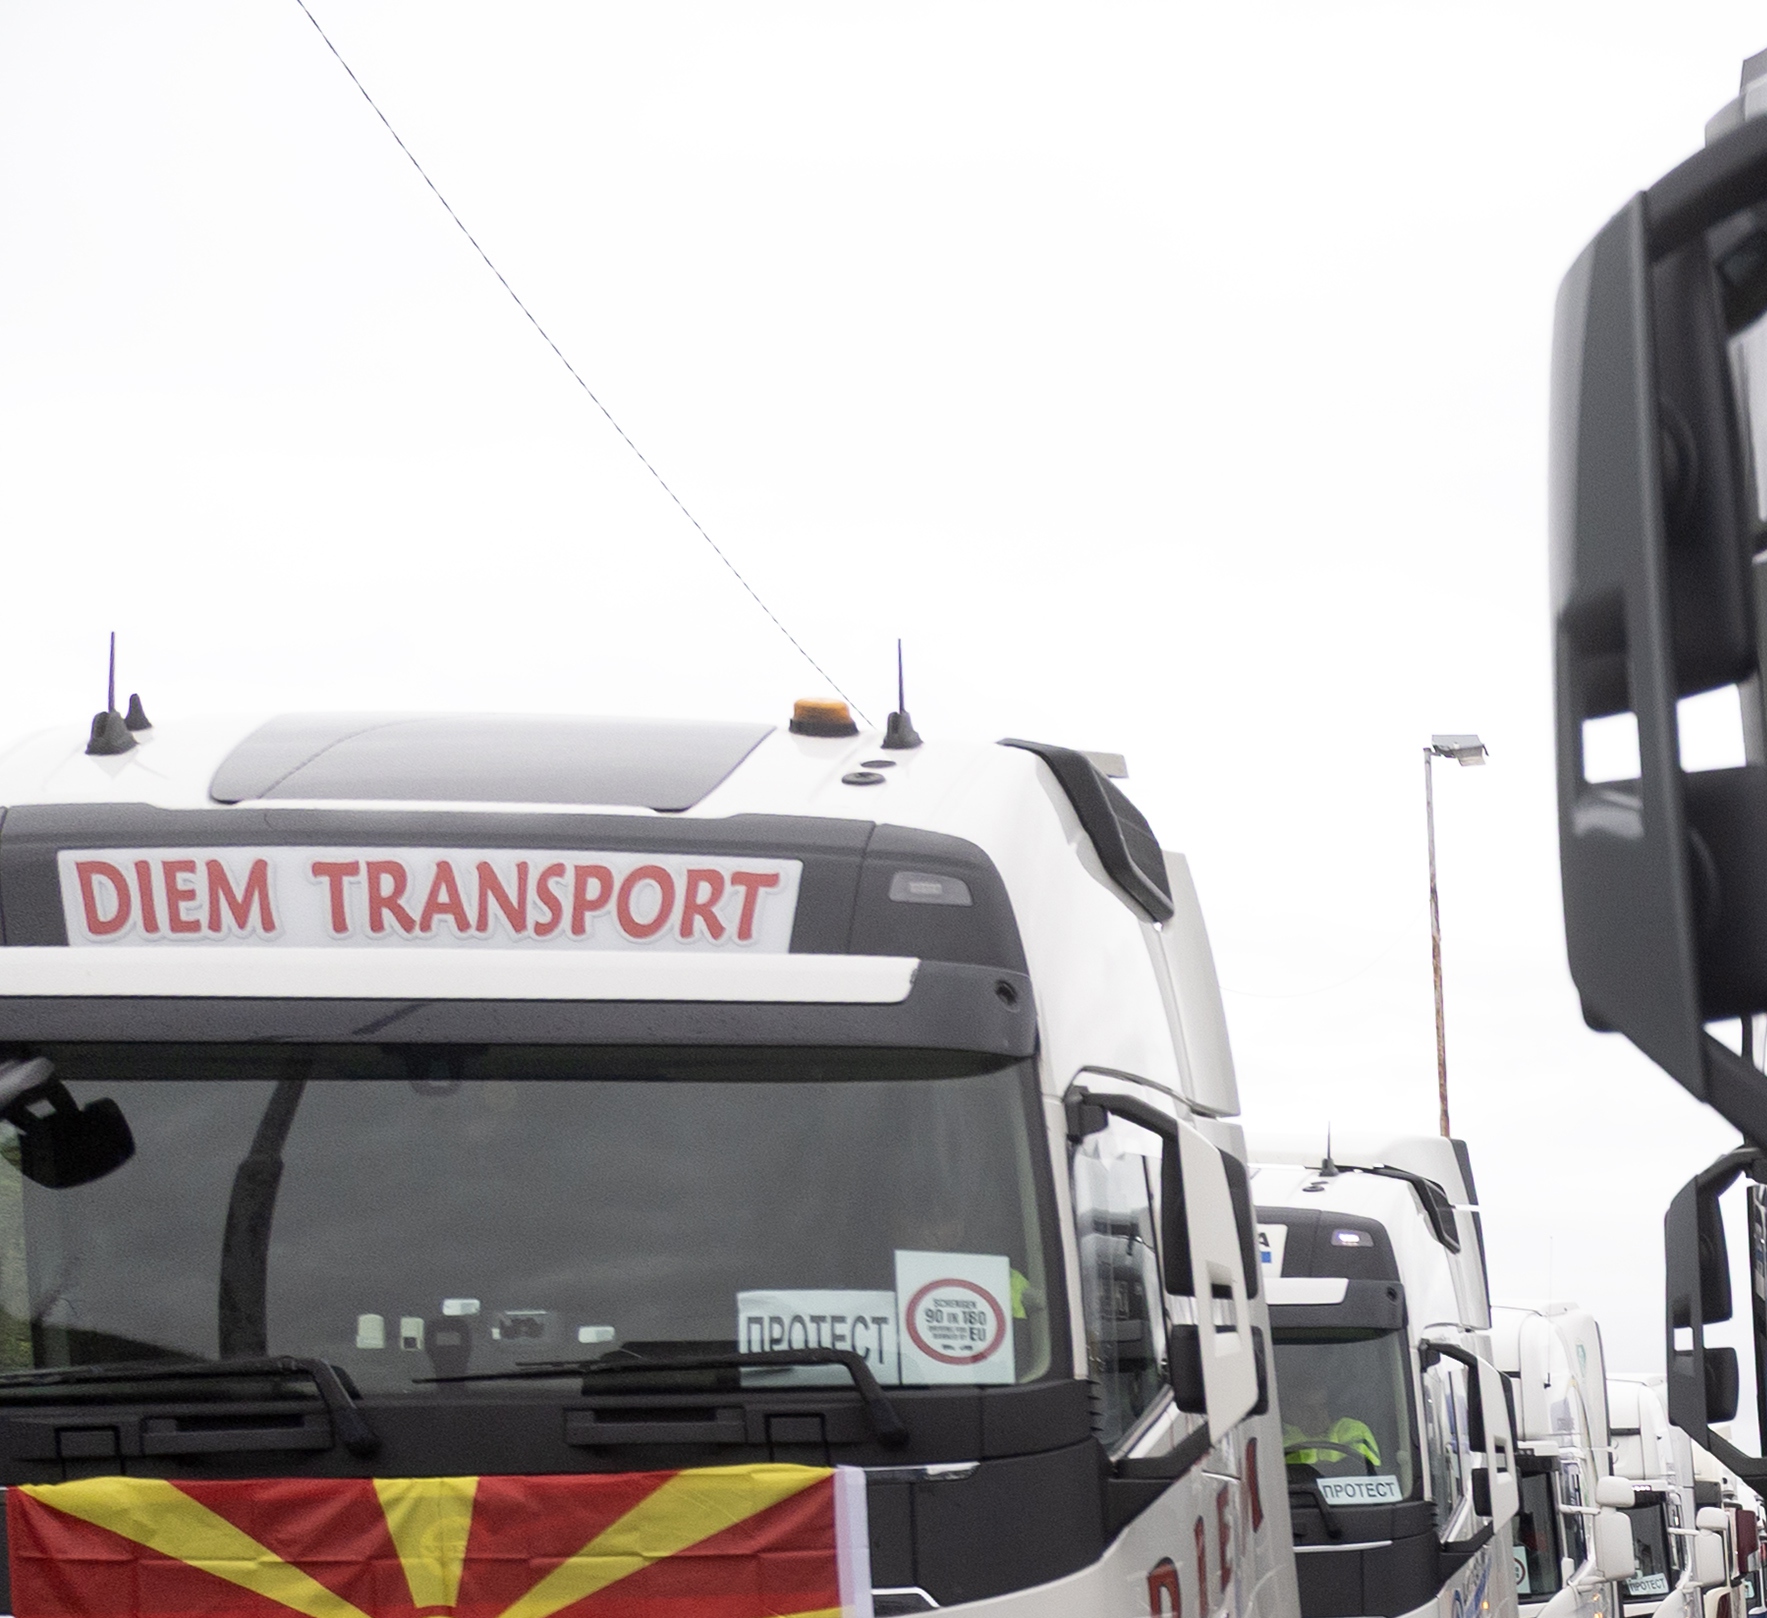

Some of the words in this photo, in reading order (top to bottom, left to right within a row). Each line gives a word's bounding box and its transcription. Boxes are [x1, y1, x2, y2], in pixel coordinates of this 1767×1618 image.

[76, 858, 275, 935] DIEM
[312, 861, 781, 942] TRANSPORT
[925, 1309, 944, 1323] 90
[747, 1315, 889, 1364] ПРОТЕСТ
[1322, 1482, 1397, 1498] ПРОТЕСТ
